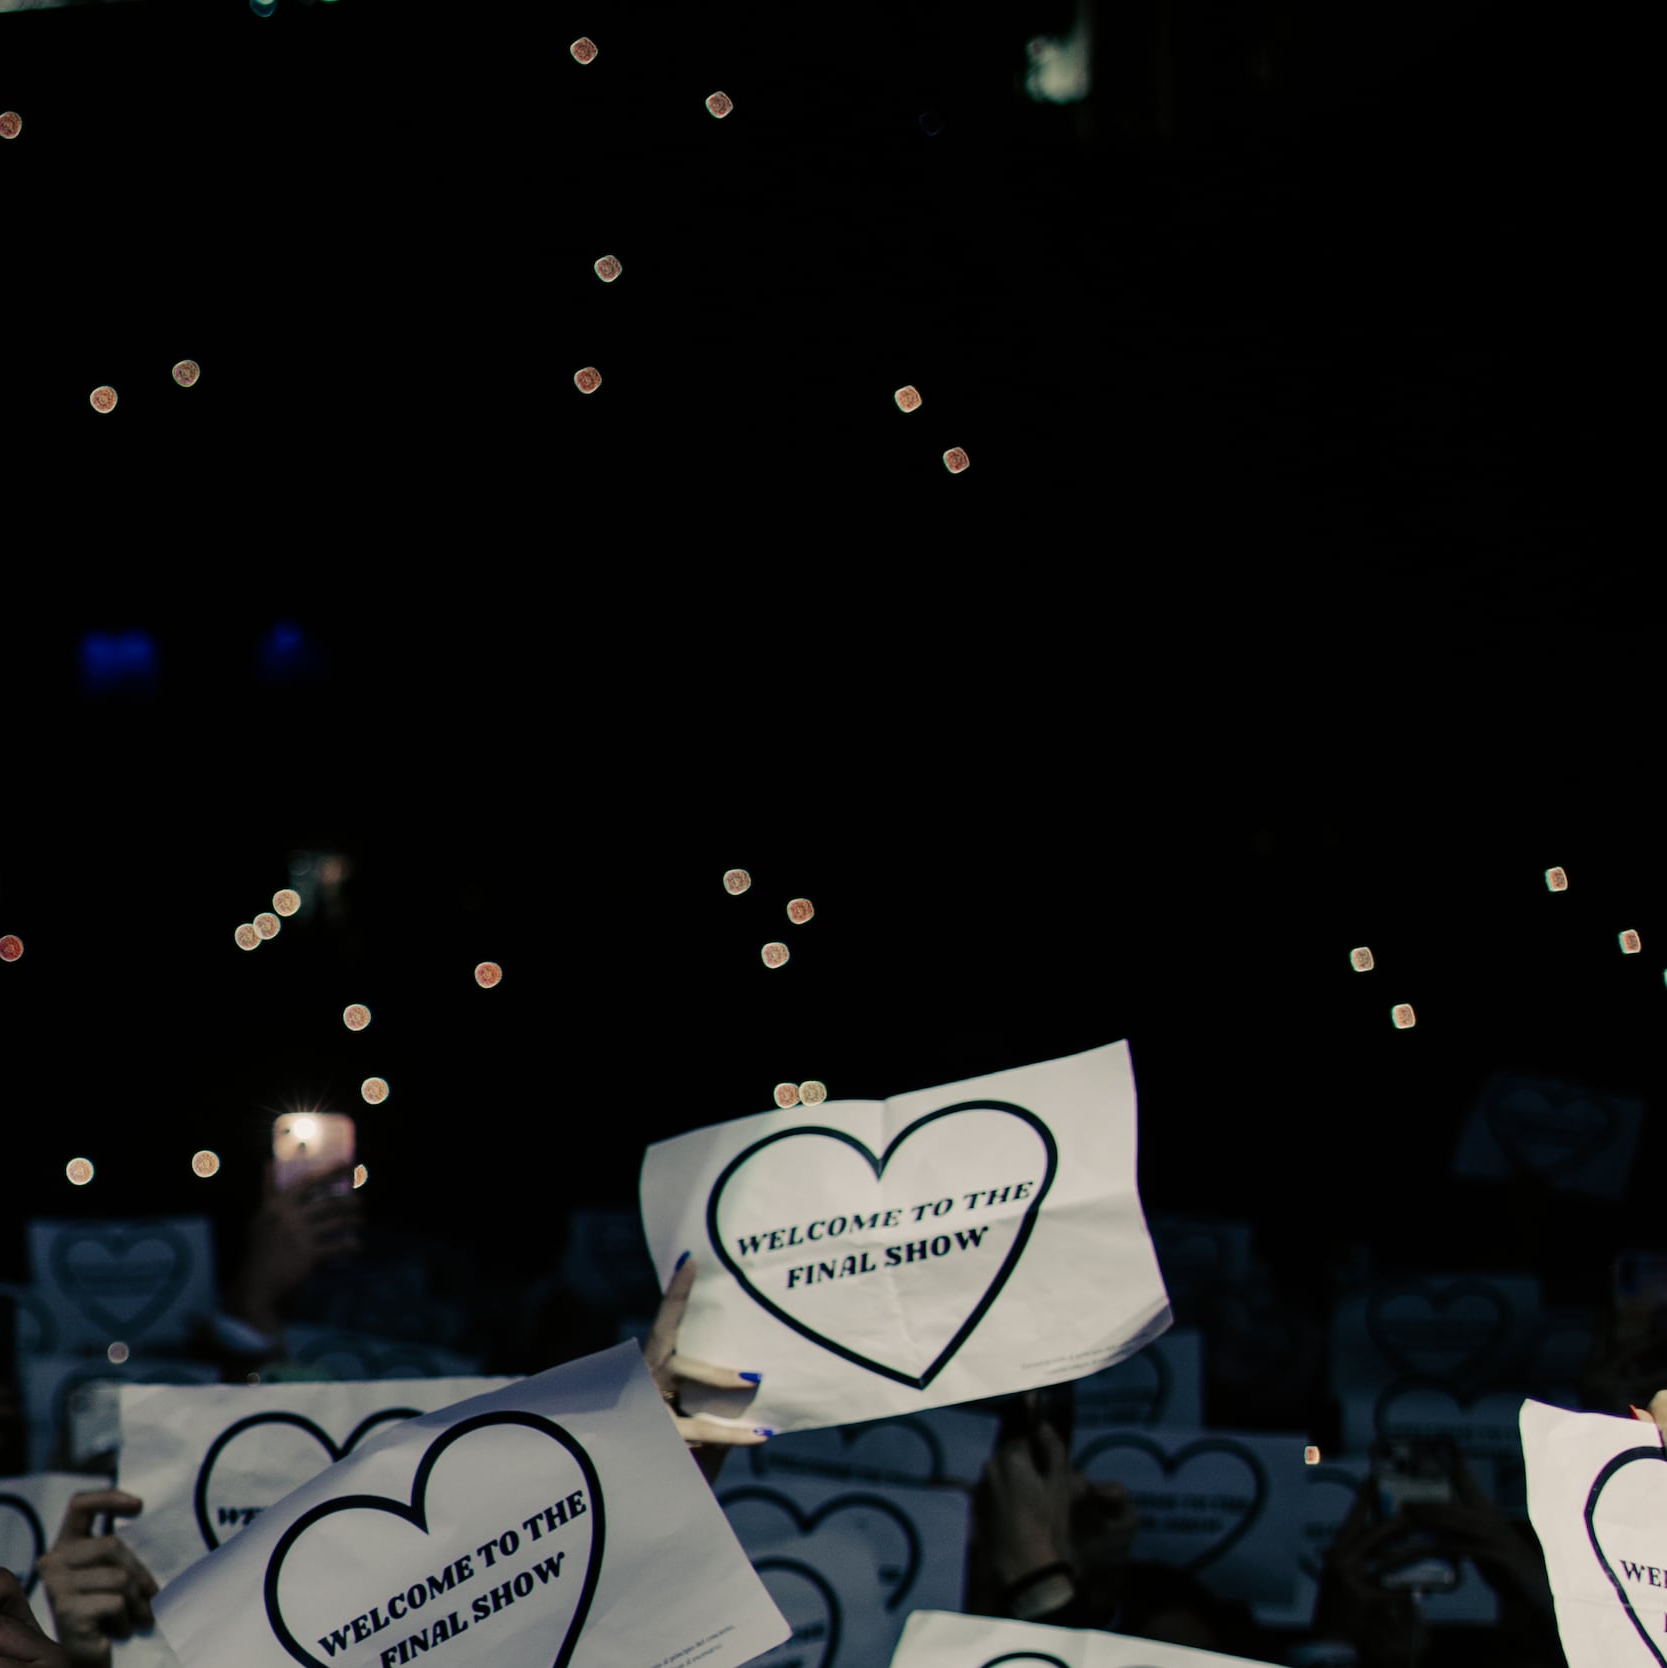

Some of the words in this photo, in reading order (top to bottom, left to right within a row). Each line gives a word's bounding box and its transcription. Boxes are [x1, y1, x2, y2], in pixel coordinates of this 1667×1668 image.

[737, 1209, 902, 1256] WELCOME
[910, 1198, 954, 1222] TO
[963, 1181, 1035, 1211] THE
[786, 1252, 877, 1290] FINAL
[884, 1226, 989, 1268] SHOW
[317, 1555, 475, 1658] WELCOME
[477, 1530, 520, 1568] TO
[522, 1489, 587, 1542] THE
[472, 1551, 565, 1624] SHOW
